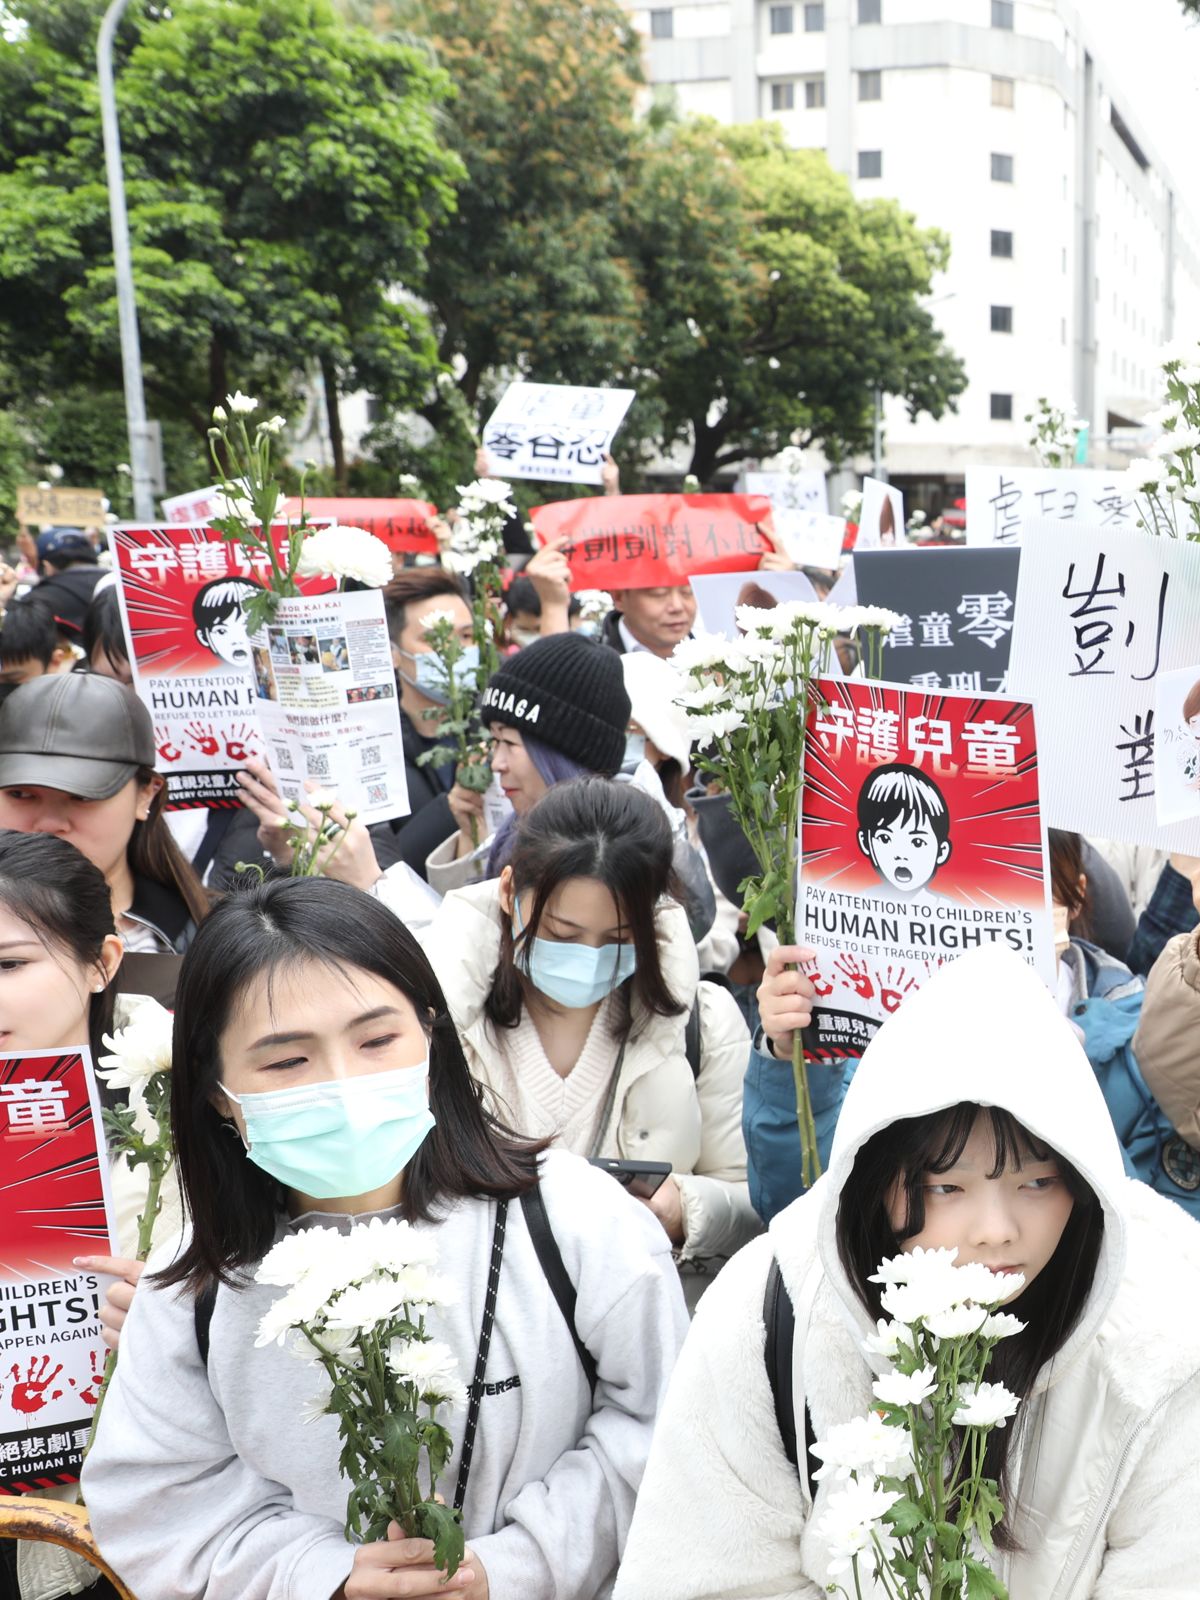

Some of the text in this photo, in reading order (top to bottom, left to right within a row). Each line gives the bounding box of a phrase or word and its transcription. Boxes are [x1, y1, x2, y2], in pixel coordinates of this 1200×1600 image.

[174, 676, 245, 688] ATTENTION
[152, 688, 239, 709] HUMAN
[815, 700, 1023, 782] 守護兒童
[805, 886, 1033, 924] PAY ATTENTION TO CHILDREN'S
[804, 903, 900, 942] HUMAN
[803, 931, 842, 950] REFUSE
[844, 940, 859, 952] TO
[860, 943, 881, 956] LET
[882, 946, 936, 962] TRAGEDY
[819, 1033, 850, 1044] EVERY
[12, 1457, 64, 1476] HUMAN
